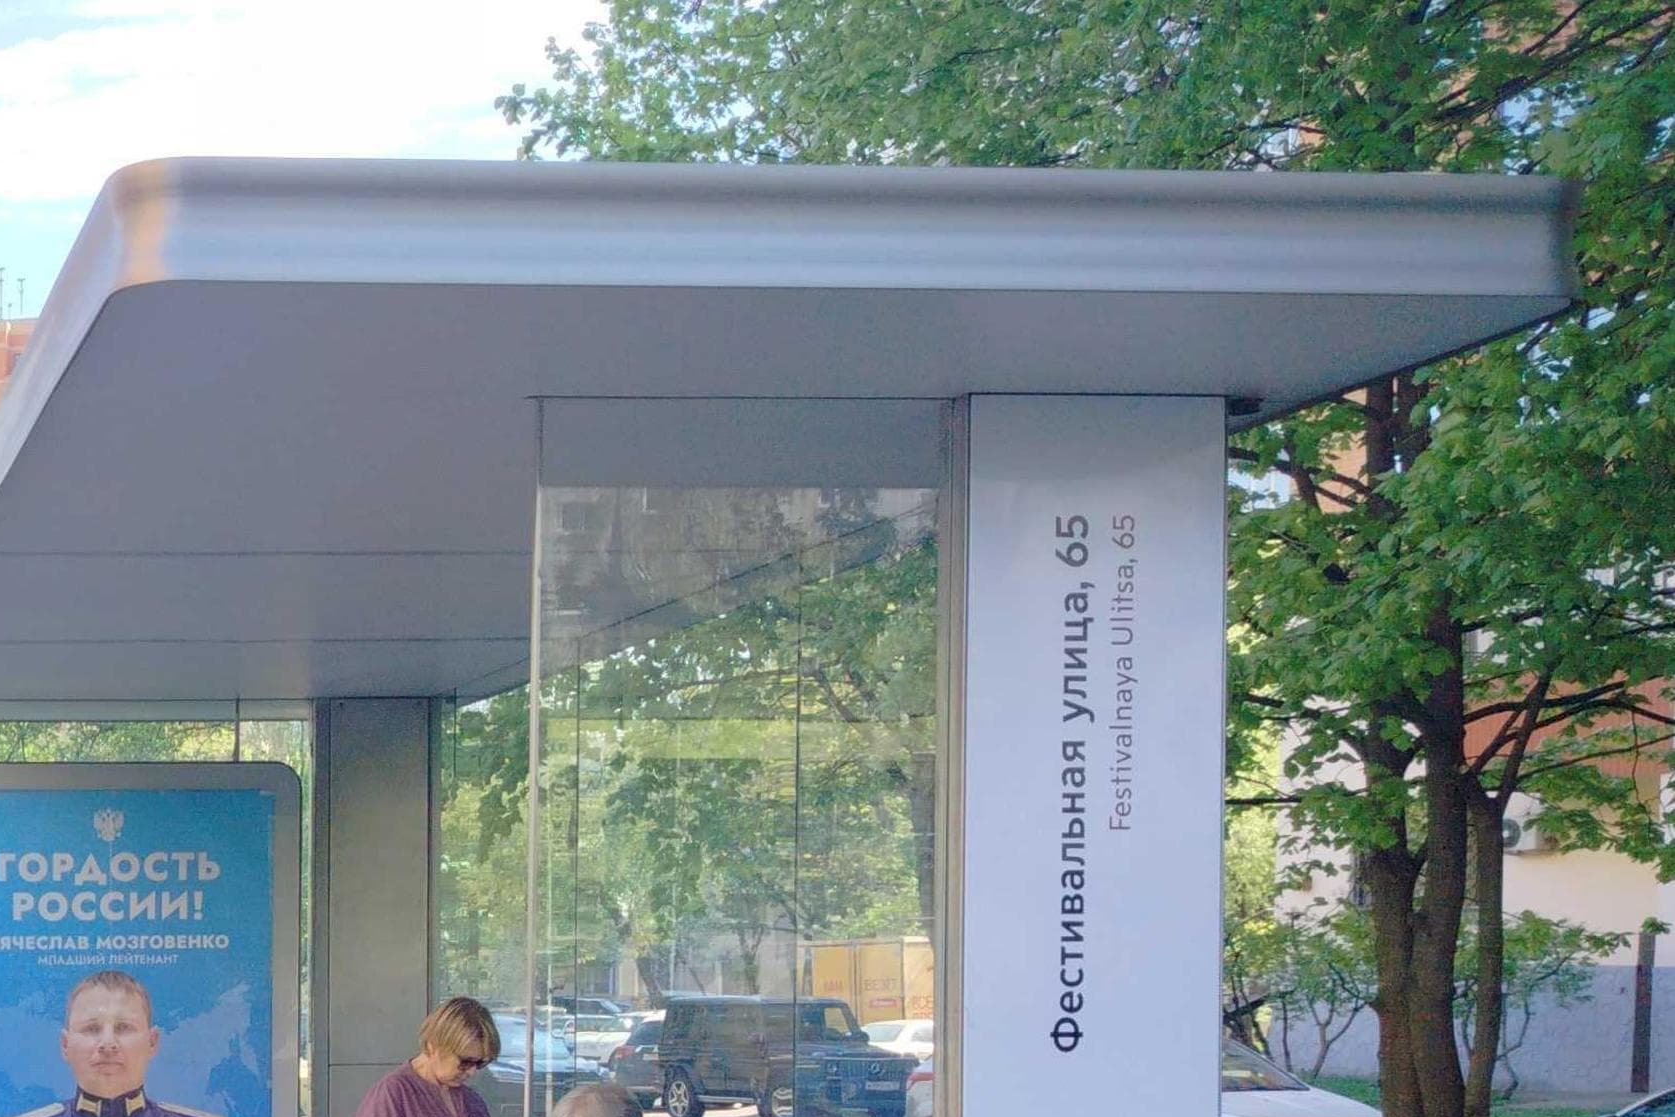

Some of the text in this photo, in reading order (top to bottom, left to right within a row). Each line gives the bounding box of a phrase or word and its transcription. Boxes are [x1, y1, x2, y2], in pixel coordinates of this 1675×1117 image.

[1109, 514, 1139, 831] Festivalnaya Ulitsa, 65
[1050, 514, 1096, 1053] Фестивальная улица, 65
[12, 890, 204, 921] РОССИИ!
[96, 934, 230, 949] МОЗГОВЕНКО
[37, 952, 179, 966] МЛАДШИЙ ЛЕЙТЕНАНТ
